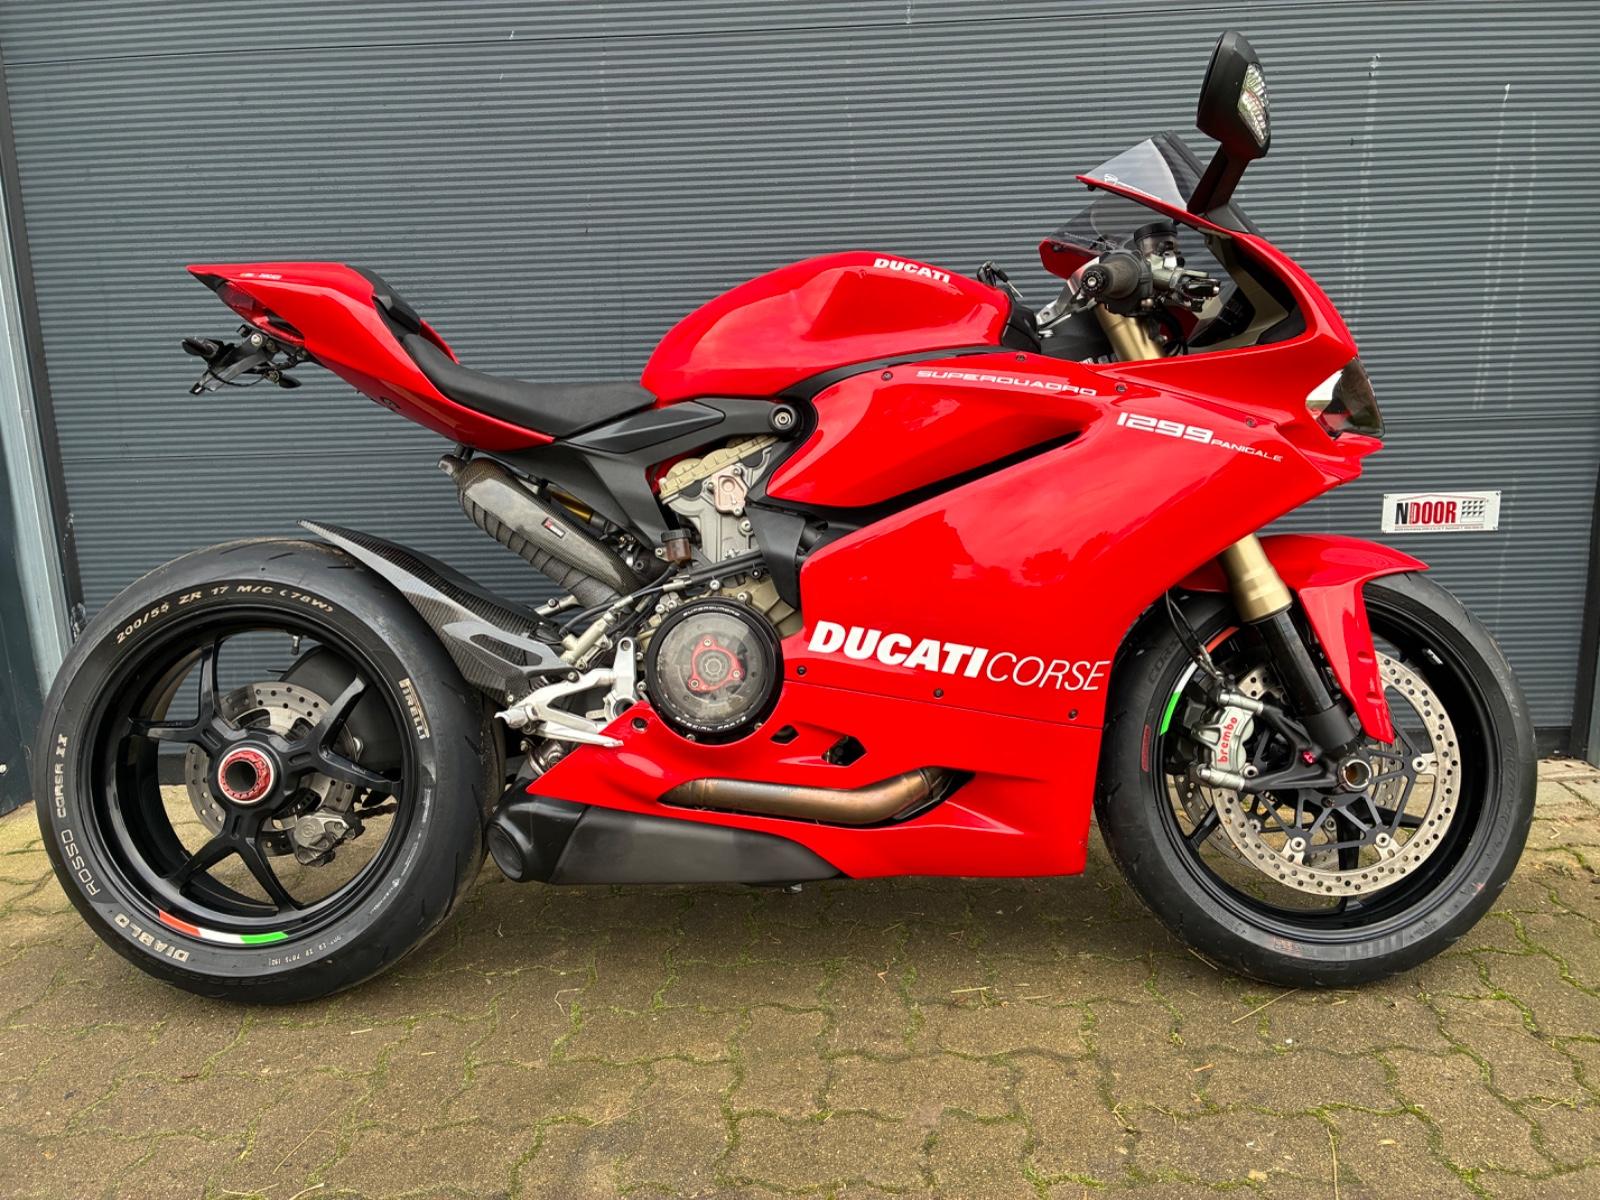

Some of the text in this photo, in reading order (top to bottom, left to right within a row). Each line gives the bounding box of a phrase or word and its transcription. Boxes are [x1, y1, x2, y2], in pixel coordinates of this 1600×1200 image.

[873, 258, 951, 284] DUCATI
[916, 370, 1097, 397] SUPERQUADRO
[1116, 412, 1284, 463] 1299 PANIGALE
[116, 602, 170, 645] 200/55
[179, 591, 203, 605] ZR
[211, 585, 230, 596] 17
[236, 584, 274, 595] M/C
[807, 620, 1111, 691] DUCATI CORSE
[1217, 716, 1238, 764] brembo
[54, 763, 67, 818] CORSA
[61, 829, 101, 896] ROSSO
[114, 912, 190, 963] DIABLO
